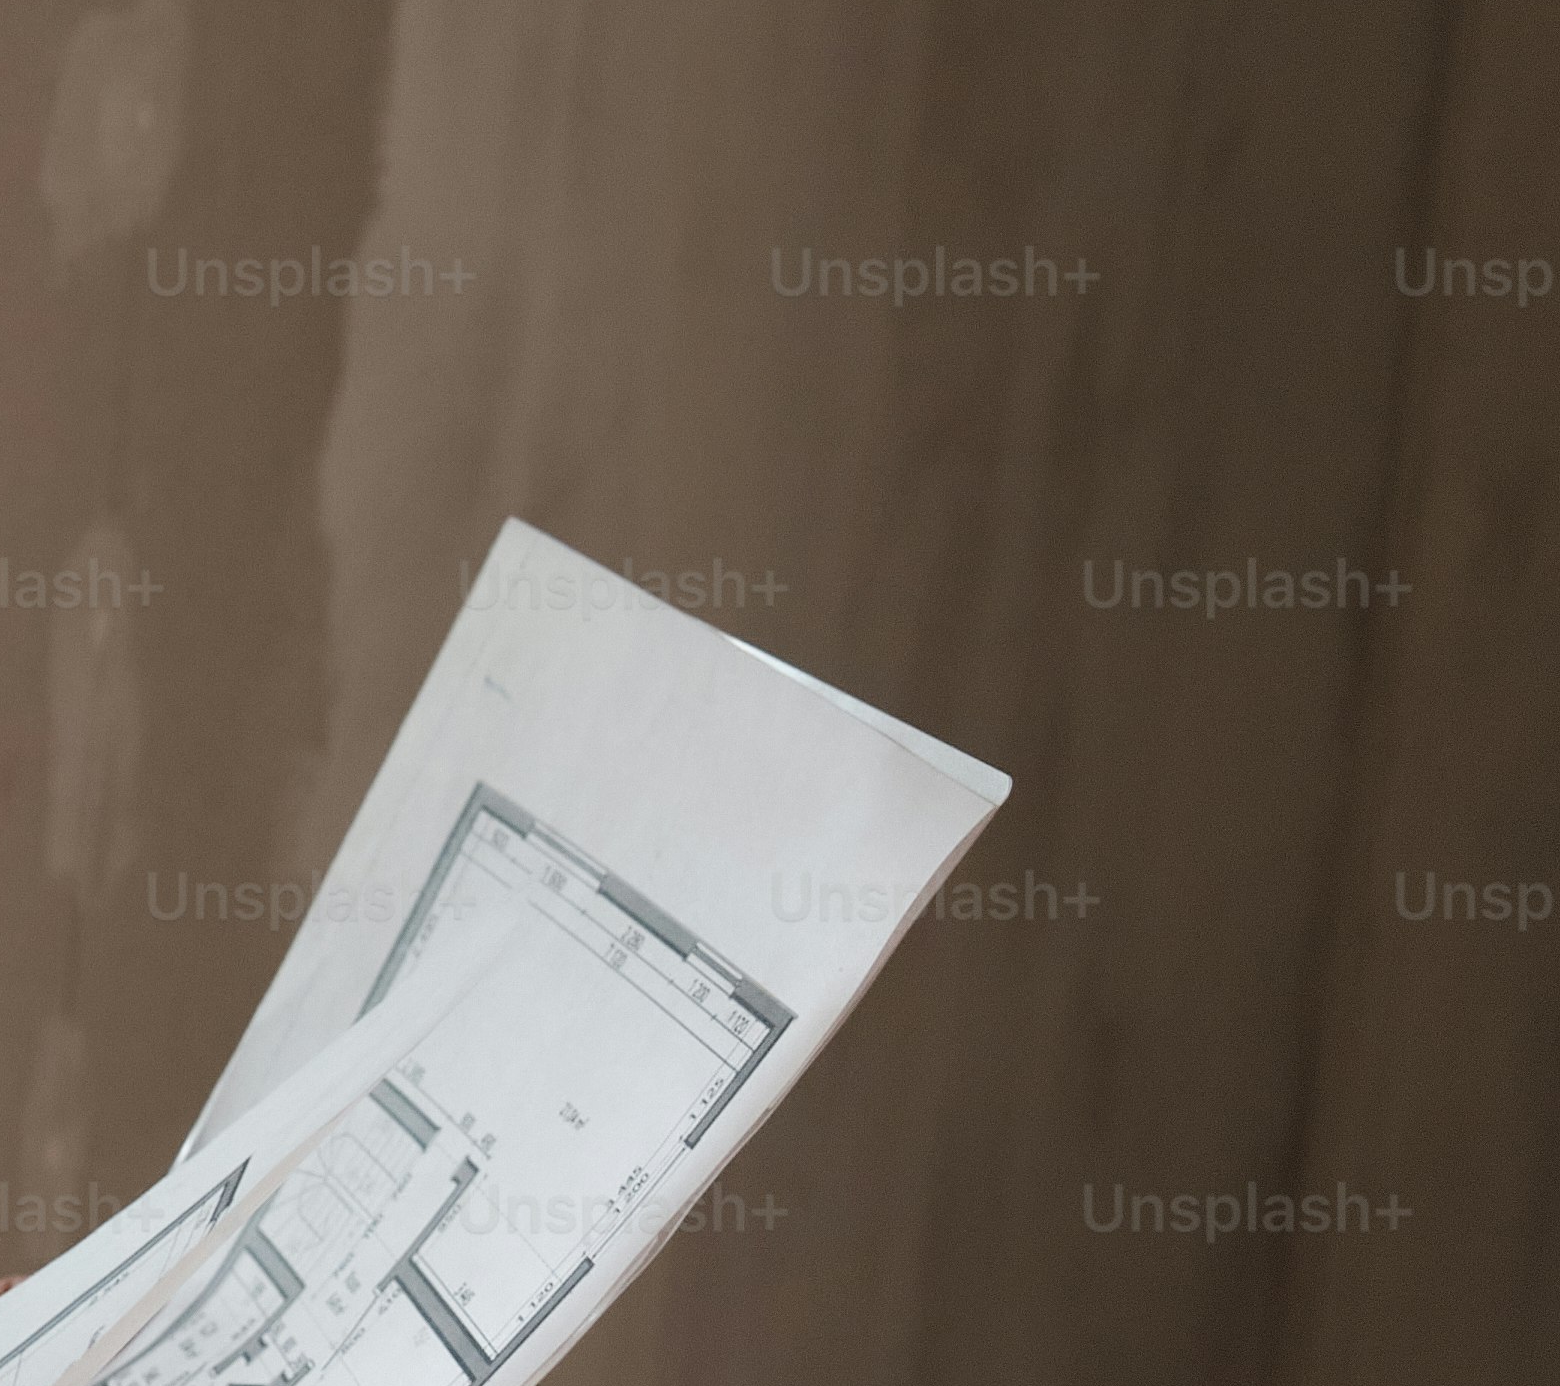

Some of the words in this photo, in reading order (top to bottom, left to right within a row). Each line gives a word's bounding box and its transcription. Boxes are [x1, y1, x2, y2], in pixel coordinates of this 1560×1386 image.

[699, 1077, 724, 1107] 125
[625, 1172, 650, 1205] 200
[529, 1281, 555, 1310] 120
